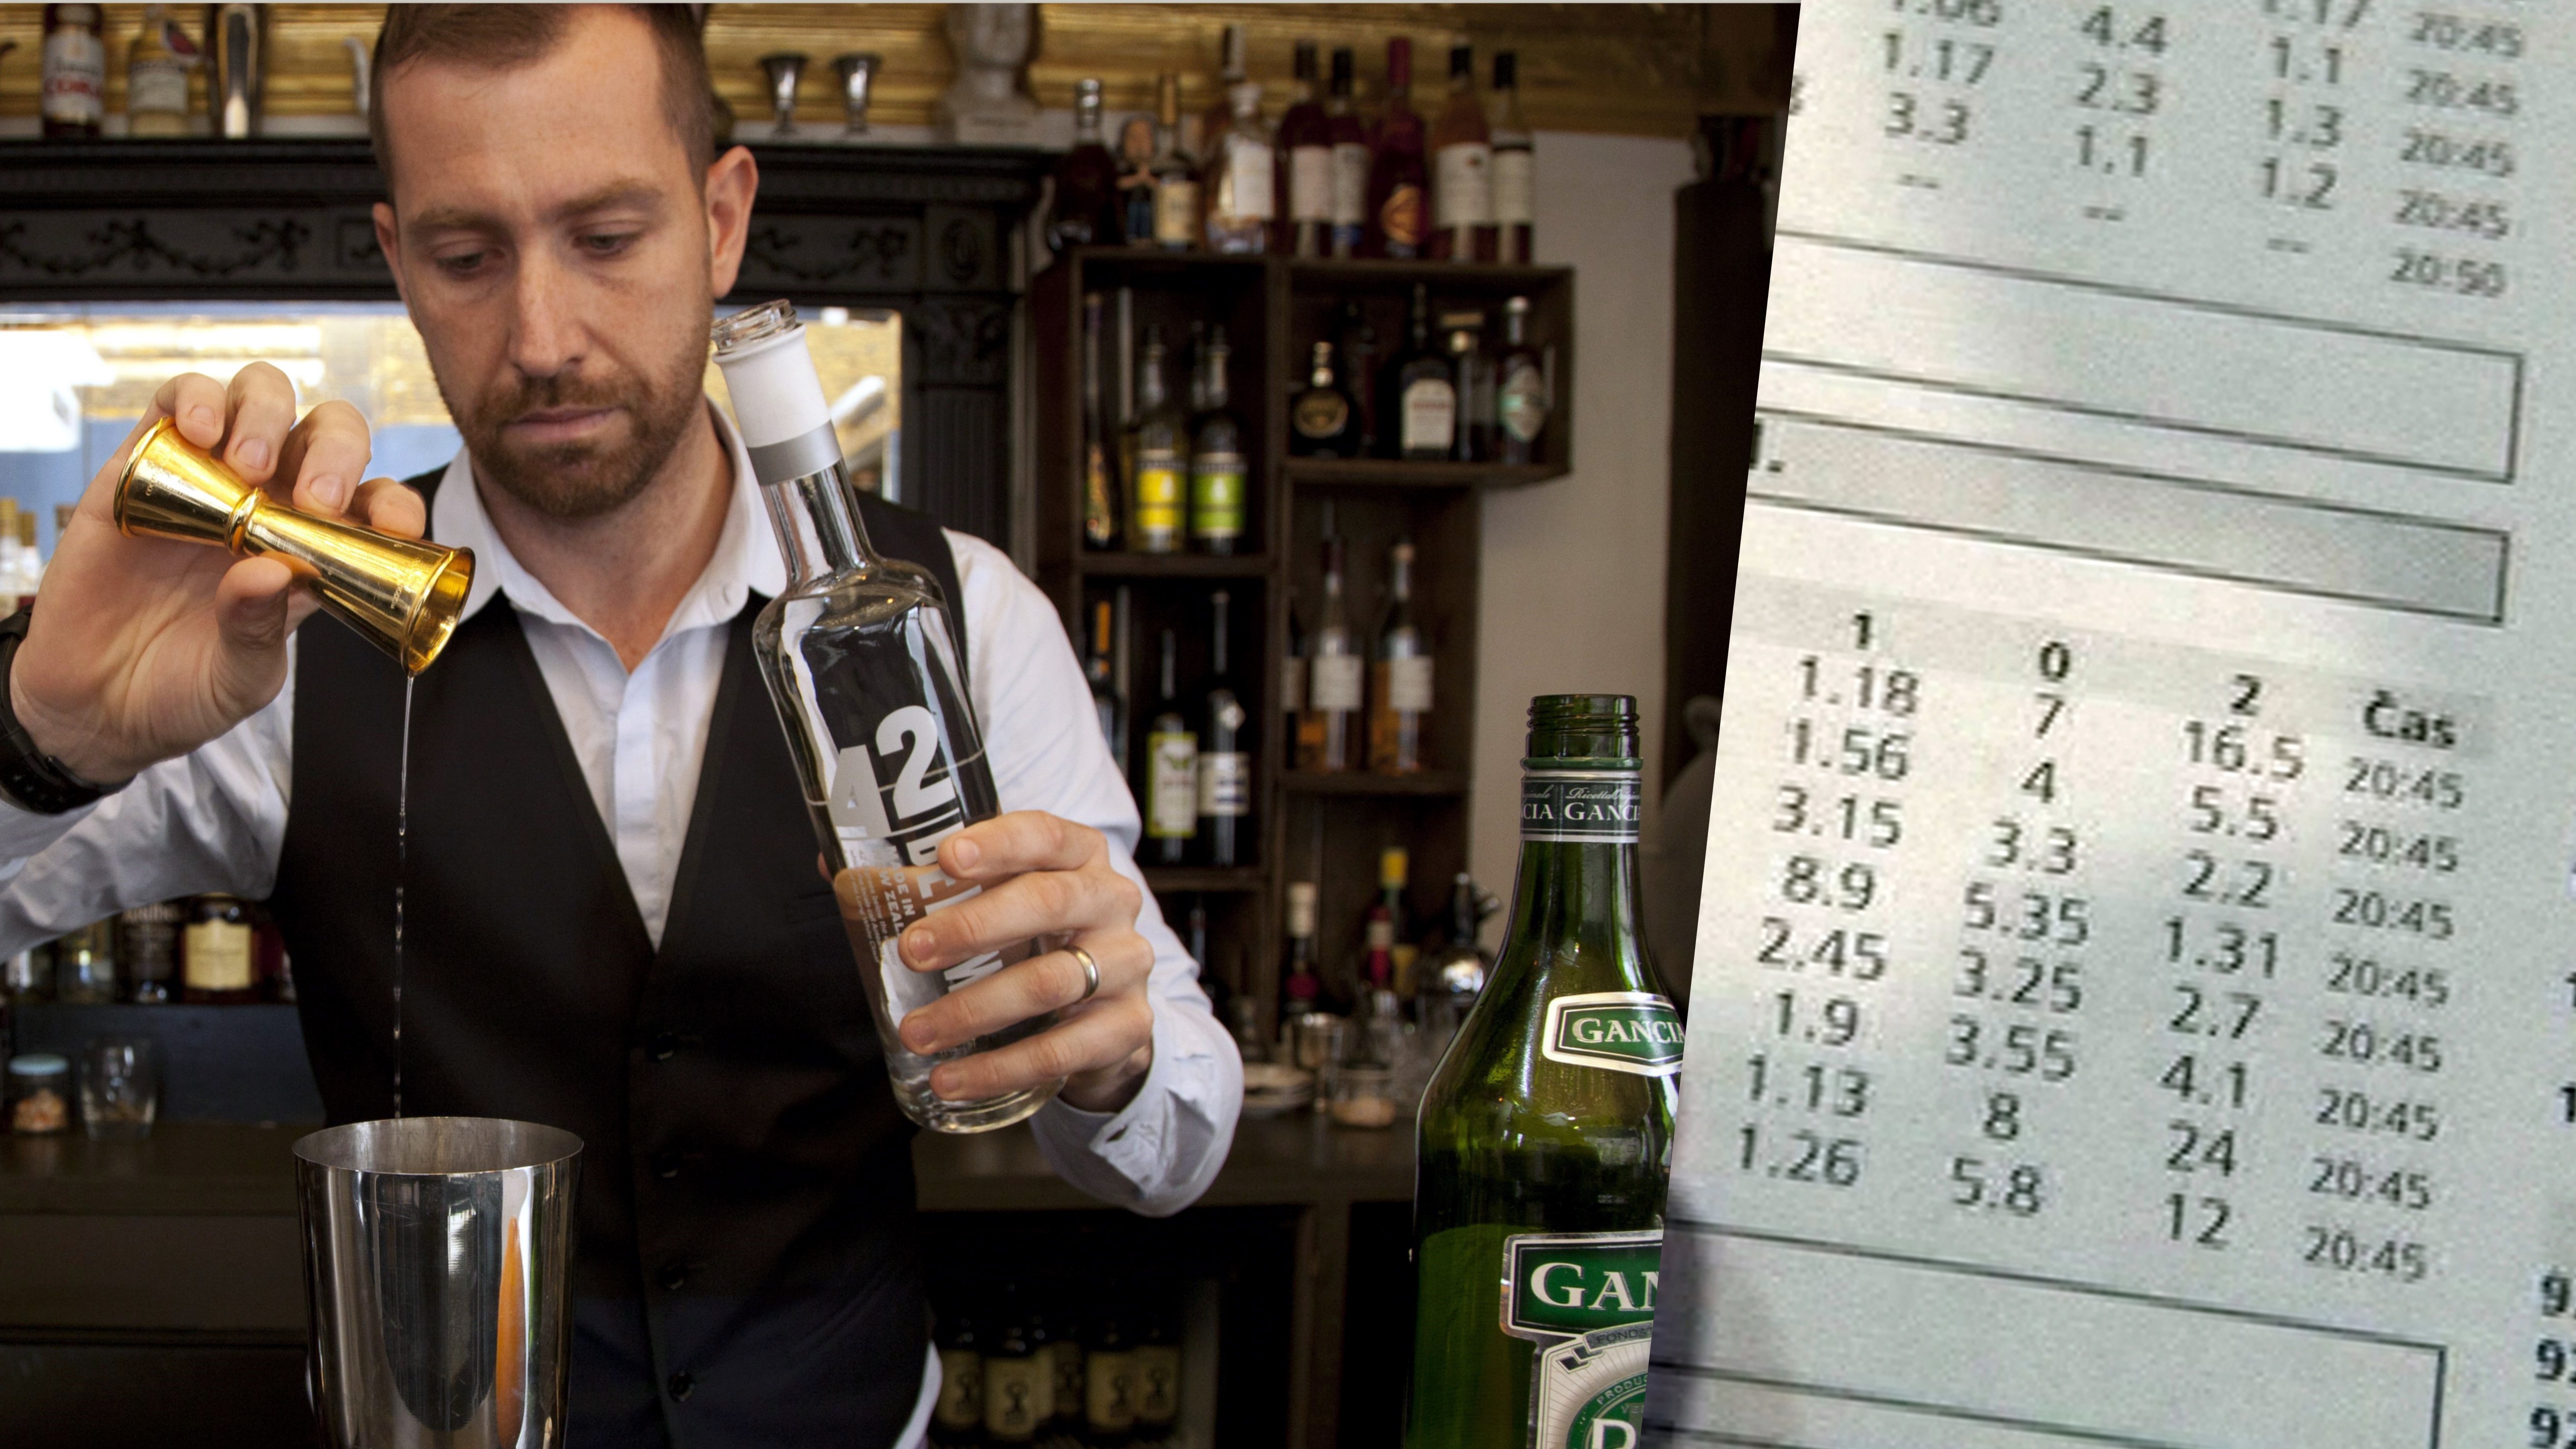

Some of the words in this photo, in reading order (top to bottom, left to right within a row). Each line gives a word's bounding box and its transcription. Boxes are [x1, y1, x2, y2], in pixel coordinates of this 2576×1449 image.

[1884, 30, 1994, 84] 1.17
[2076, 61, 2159, 116] 2.3
[2267, 99, 2343, 147] 1.3
[2400, 130, 2516, 177] 20:45
[2081, 6, 2165, 55] 4.4
[2270, 35, 2341, 84] 1.1
[2406, 68, 2518, 115] 20:45
[2410, 12, 2522, 57] 20:45
[1884, 92, 1967, 145] 3.3
[2076, 125, 2147, 177] 1.1
[2262, 157, 2338, 210] 1.2
[2393, 189, 2510, 240] 20:45
[2389, 248, 2506, 298] 20:50
[1801, 656, 1918, 716] 1.18
[2036, 693, 2066, 740] 7
[2185, 720, 2304, 781] 16.5
[2345, 758, 2463, 809] 20:45
[1853, 610, 1873, 650] 1
[2039, 641, 2072, 683] 0
[2229, 674, 2262, 716] 2
[2363, 689, 2457, 750] Čas
[1523, 803, 1554, 819] CIA
[1564, 802, 1640, 821] GANCI
[1773, 785, 1902, 849] 3.15
[1986, 817, 2077, 875] 3.3
[2184, 849, 2271, 908] 2.2
[2332, 889, 2454, 940] 20:45
[1789, 717, 1911, 781] 1.56
[2021, 759, 2056, 804] 4
[2190, 785, 2278, 842] 5.5
[2339, 821, 2459, 873] 20:45
[884, 890, 905, 938] ZEAL
[902, 898, 915, 916] IN
[1781, 854, 1877, 910] 8.9
[1965, 881, 2089, 946] 5.35
[2165, 916, 2278, 979] 1.31
[2327, 951, 2448, 1006] 20:45
[1757, 916, 1888, 981] 2.45
[1954, 946, 2082, 1013] 3.25
[2168, 985, 2262, 1039] 2.7
[2321, 1019, 2443, 1074] 20:45
[1777, 989, 1858, 1046] 1.9
[1945, 1014, 2076, 1081] 3.55
[2160, 1054, 2247, 1108] 4.1
[2315, 1088, 2438, 1142] 20:45
[1739, 1123, 1860, 1188] 1.26
[1951, 1157, 2042, 1218] 5.8
[2166, 1193, 2231, 1251] 12
[2303, 1225, 2428, 1282] 20:45
[1747, 1054, 1870, 1118] 1.13
[1982, 1092, 2020, 1142] 8
[2165, 1120, 2236, 1177] 24
[2309, 1156, 2431, 1211] 20:45
